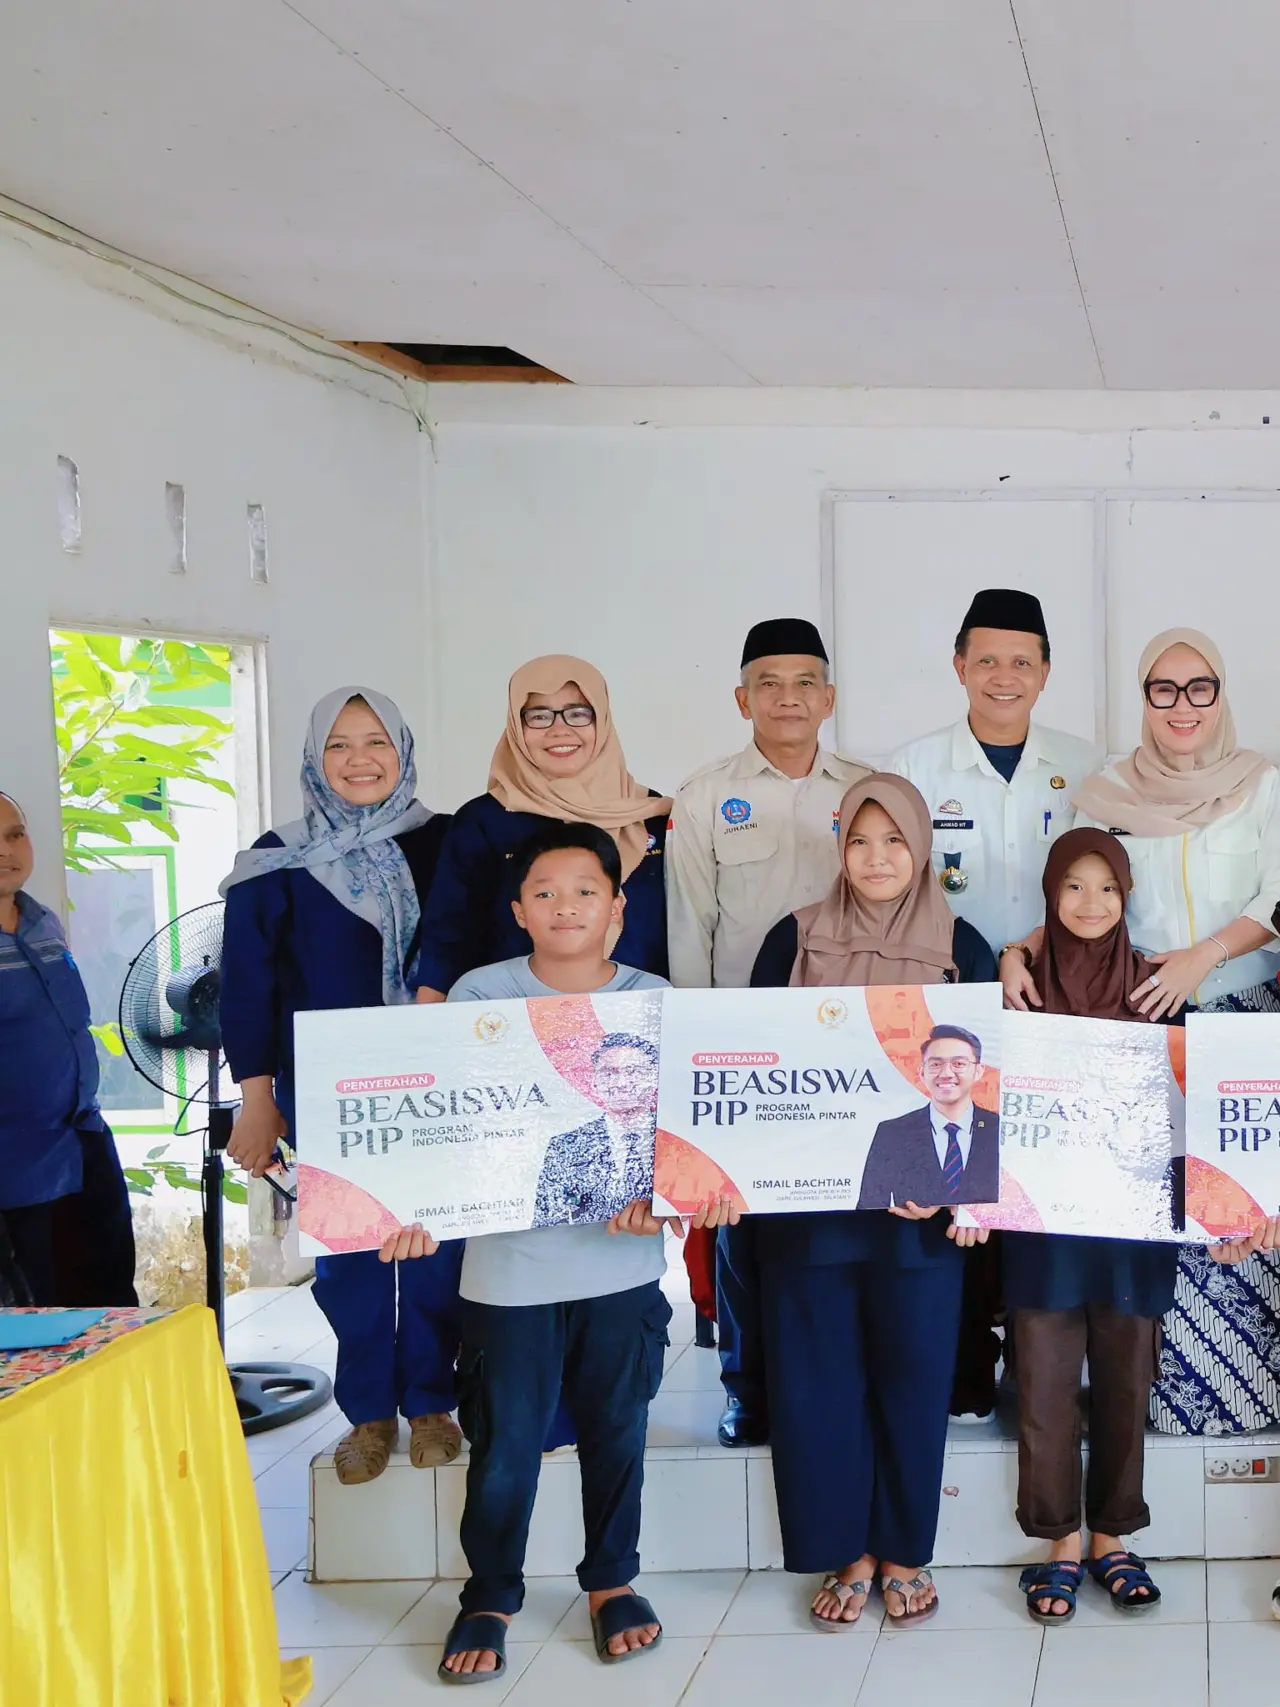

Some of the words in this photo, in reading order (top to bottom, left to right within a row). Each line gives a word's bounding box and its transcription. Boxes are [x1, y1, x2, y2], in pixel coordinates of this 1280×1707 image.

[724, 822, 758, 834] JUHAENI
[699, 1054, 774, 1064] PENYERAHAN
[343, 1075, 428, 1091] PENYERAHAN
[692, 1068, 880, 1096] BEASISWA
[337, 1083, 551, 1126] BEASISWA
[755, 1103, 810, 1112] PROGRAM
[691, 1100, 748, 1126] PIP
[755, 1112, 816, 1122] INDONESIA
[818, 1112, 856, 1120] PINTAR
[338, 1126, 403, 1159] PIP
[1000, 1121, 1051, 1148] PIP
[1218, 1127, 1272, 1152] PIP
[752, 1179, 792, 1188] ISMAIL
[794, 1178, 851, 1188] BACHTIAR
[414, 1206, 455, 1218] ISMAIL
